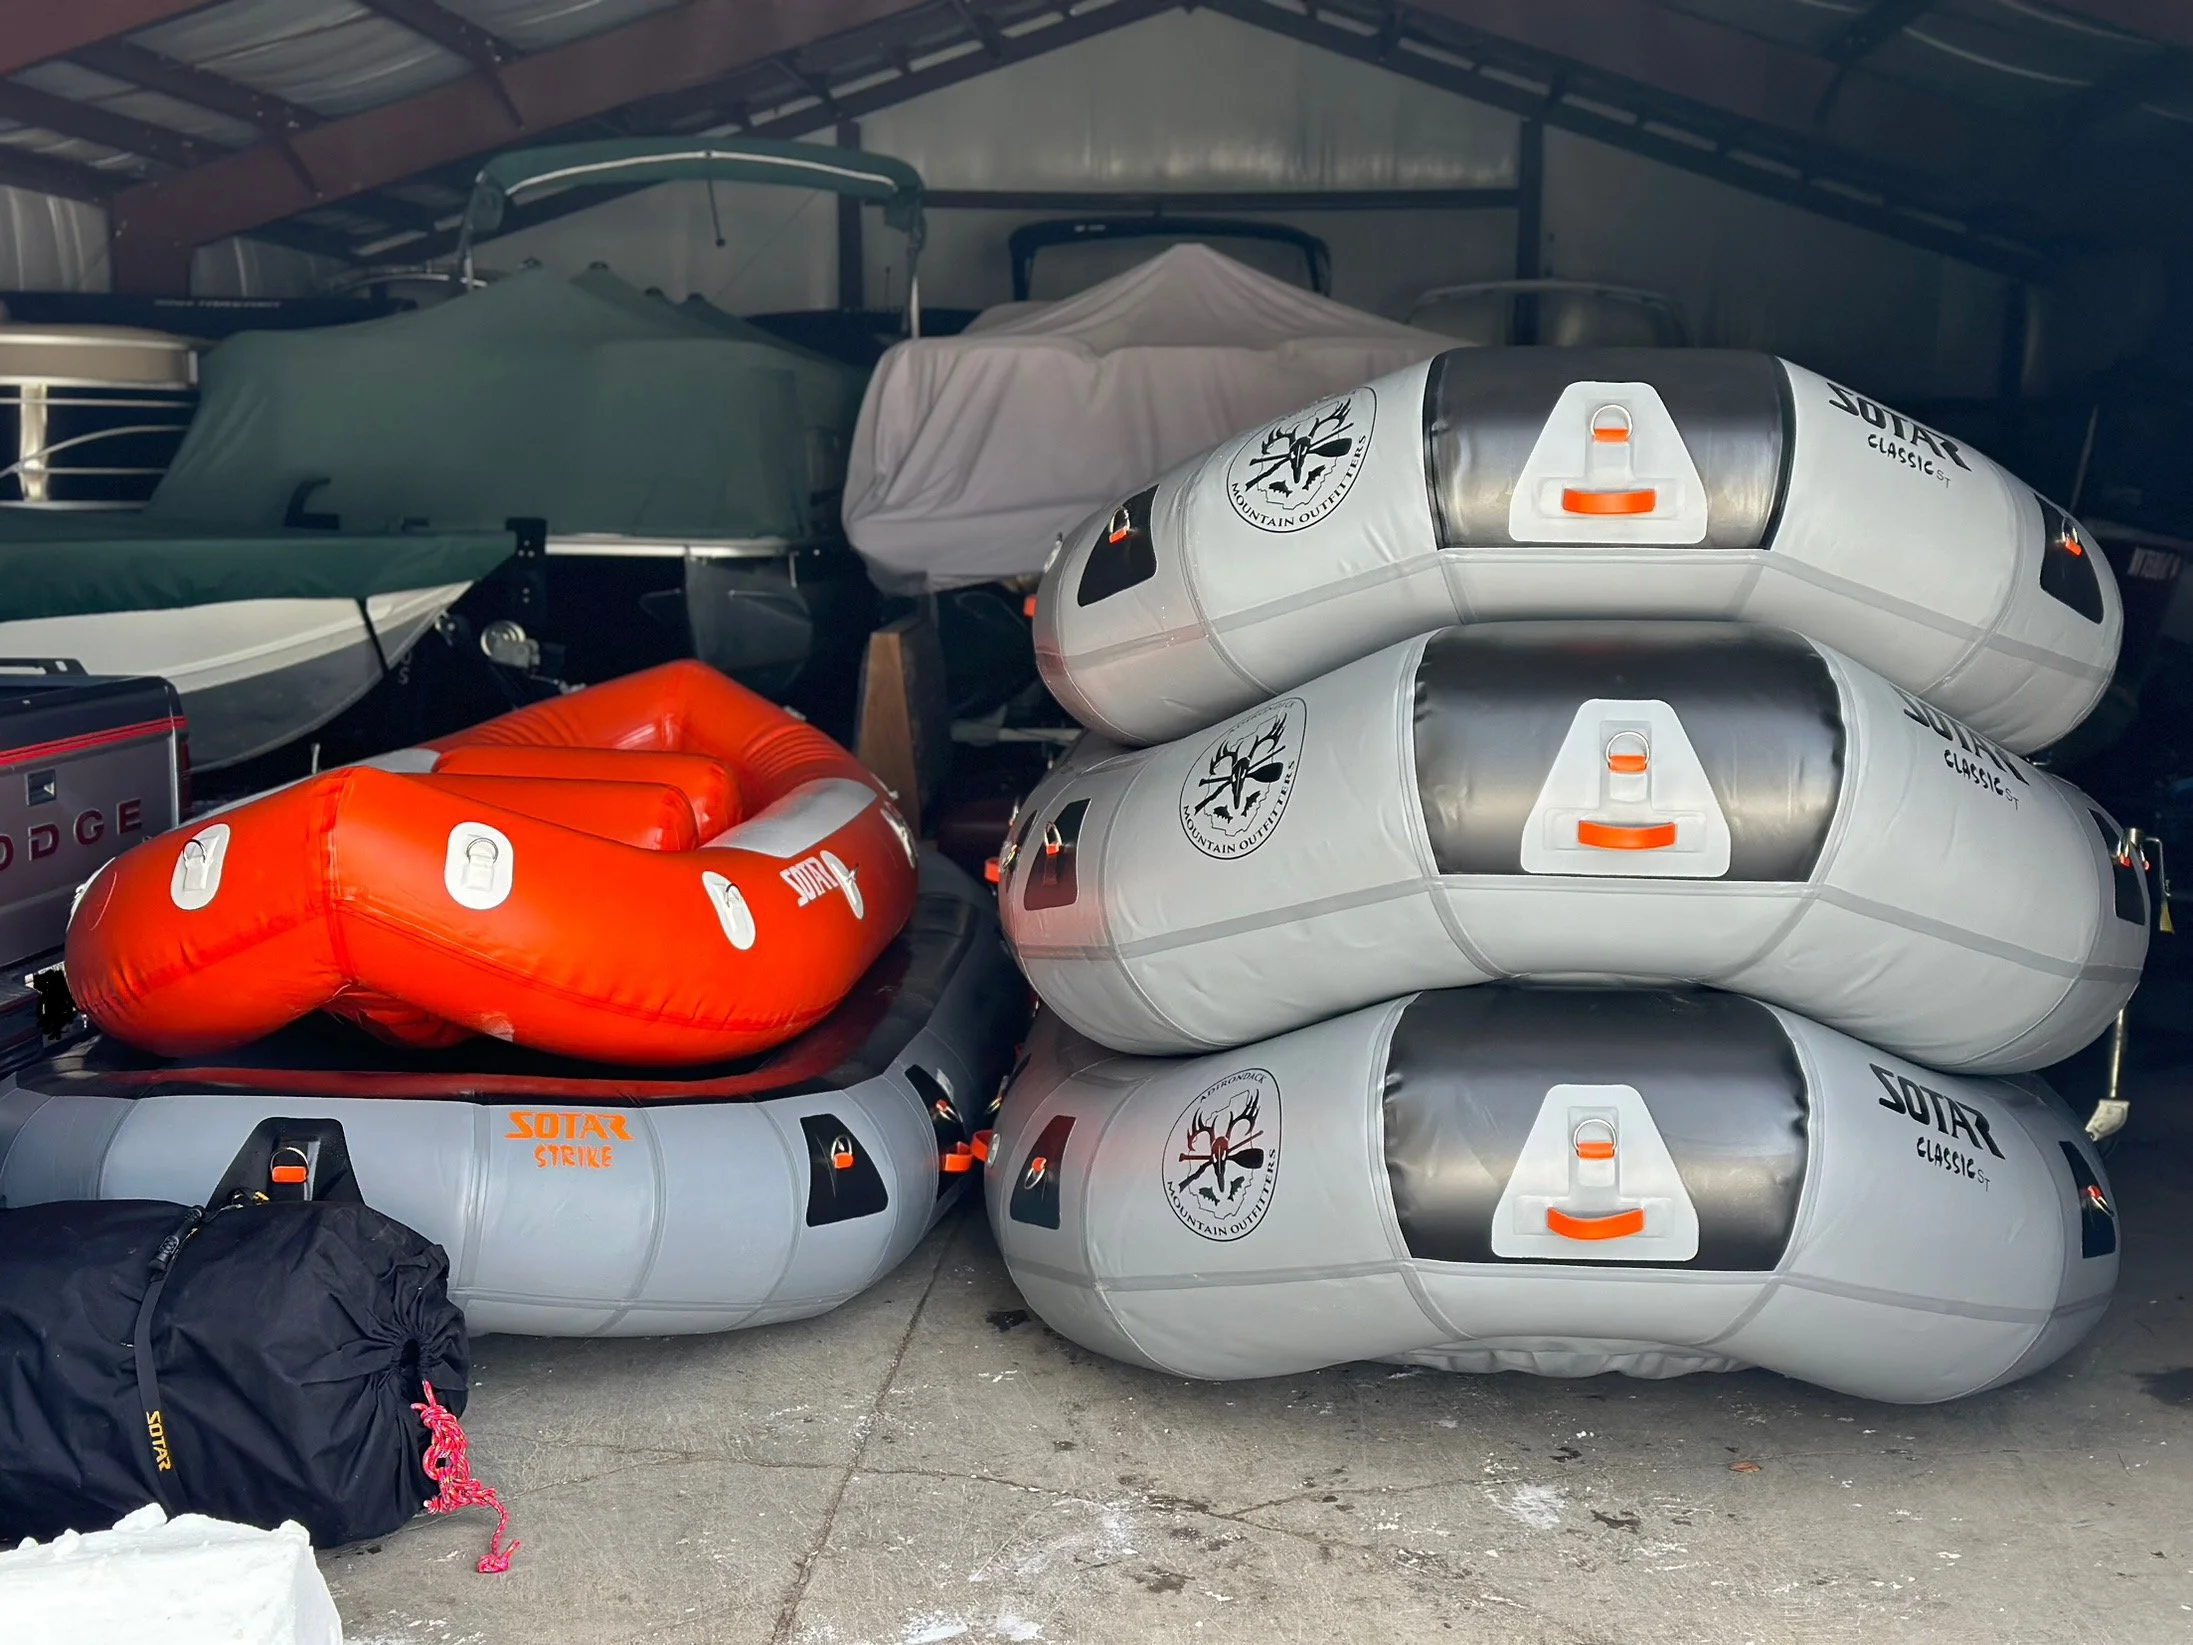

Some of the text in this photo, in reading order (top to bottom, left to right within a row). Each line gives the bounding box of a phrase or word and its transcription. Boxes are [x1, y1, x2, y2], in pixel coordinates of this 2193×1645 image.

[1827, 382, 1972, 472] SOTAR
[1232, 435, 1367, 527] MOUNTAIN OUTFITTERS
[1867, 434, 1934, 475] CLASSIC
[1944, 749, 2004, 796] CLASSIC
[1183, 760, 1295, 854] MOUNTAIN OUTFITTERS
[1200, 1072, 1266, 1103] ADIRONDACK
[1869, 1063, 2006, 1160] SOTAR
[504, 1110, 636, 1141] SOTAR
[533, 1143, 614, 1169] STRIKE
[1916, 1137, 1976, 1179] CLASSIC
[1167, 1148, 1276, 1236] MOUNTAIN OUTFITTERS
[145, 1410, 172, 1472] SOTAR
